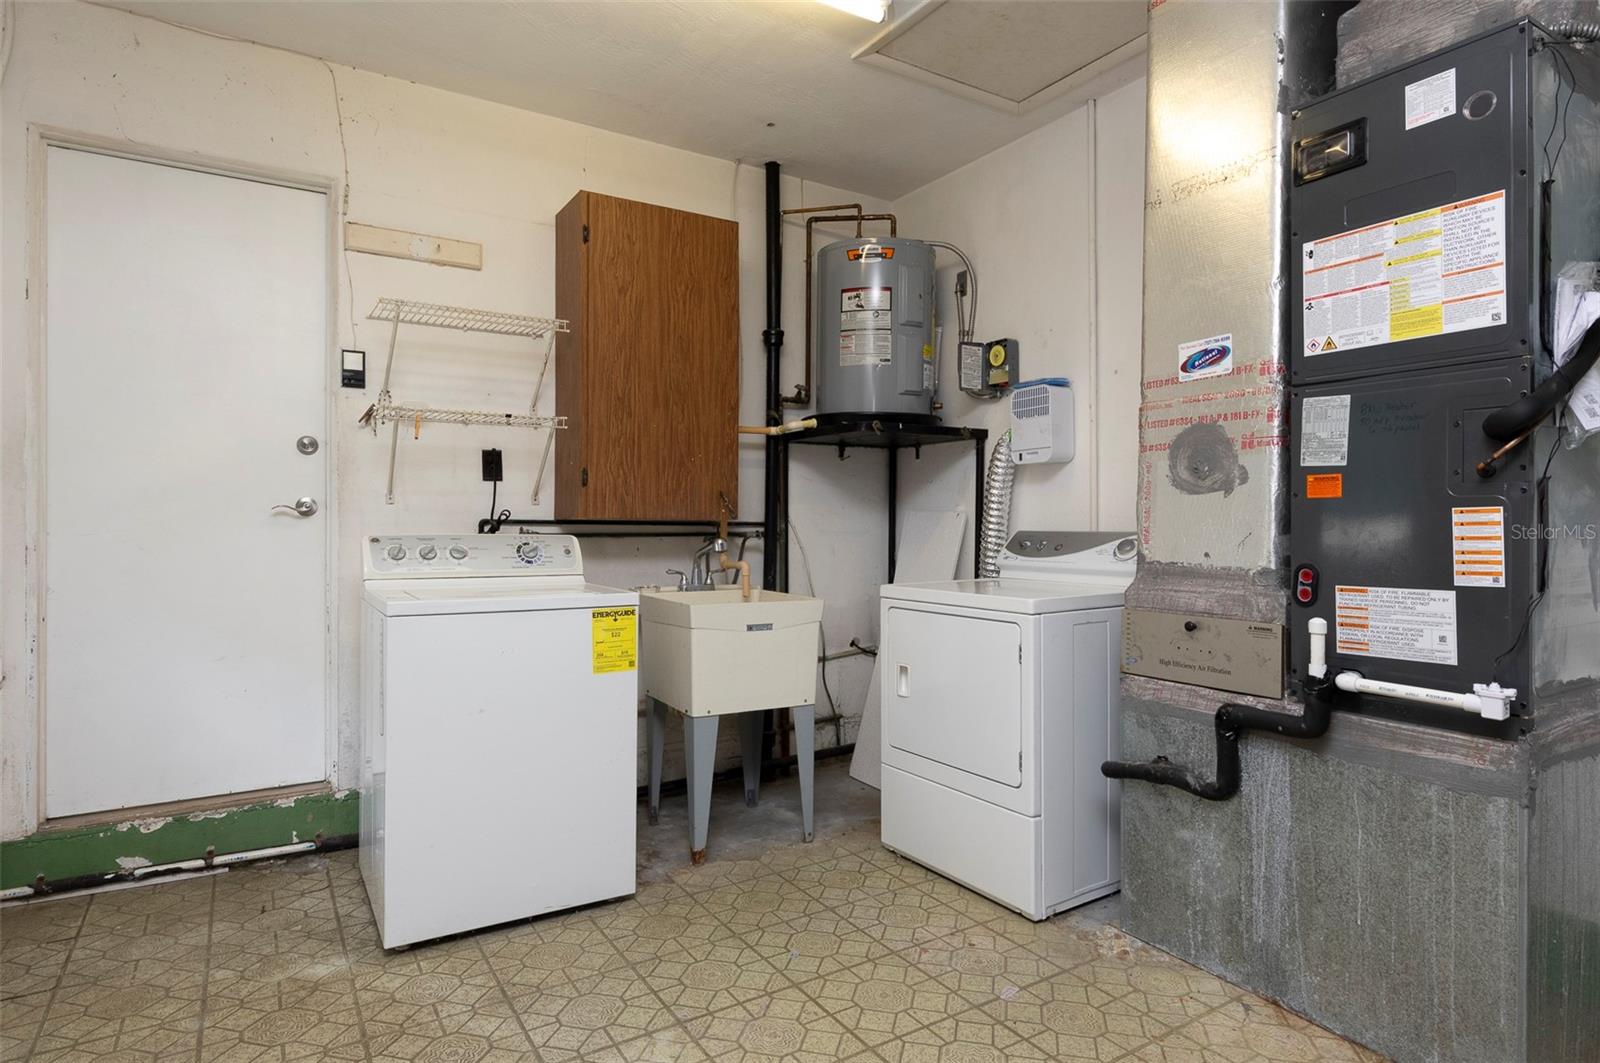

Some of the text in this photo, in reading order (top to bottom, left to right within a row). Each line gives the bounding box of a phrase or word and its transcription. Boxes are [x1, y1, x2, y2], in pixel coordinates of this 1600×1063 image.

[592, 610, 636, 618] ENERGYGUIDE
[1160, 658, 1172, 667] High
[1172, 660, 1196, 672] Efficiency
[1207, 666, 1232, 675] Filtration
